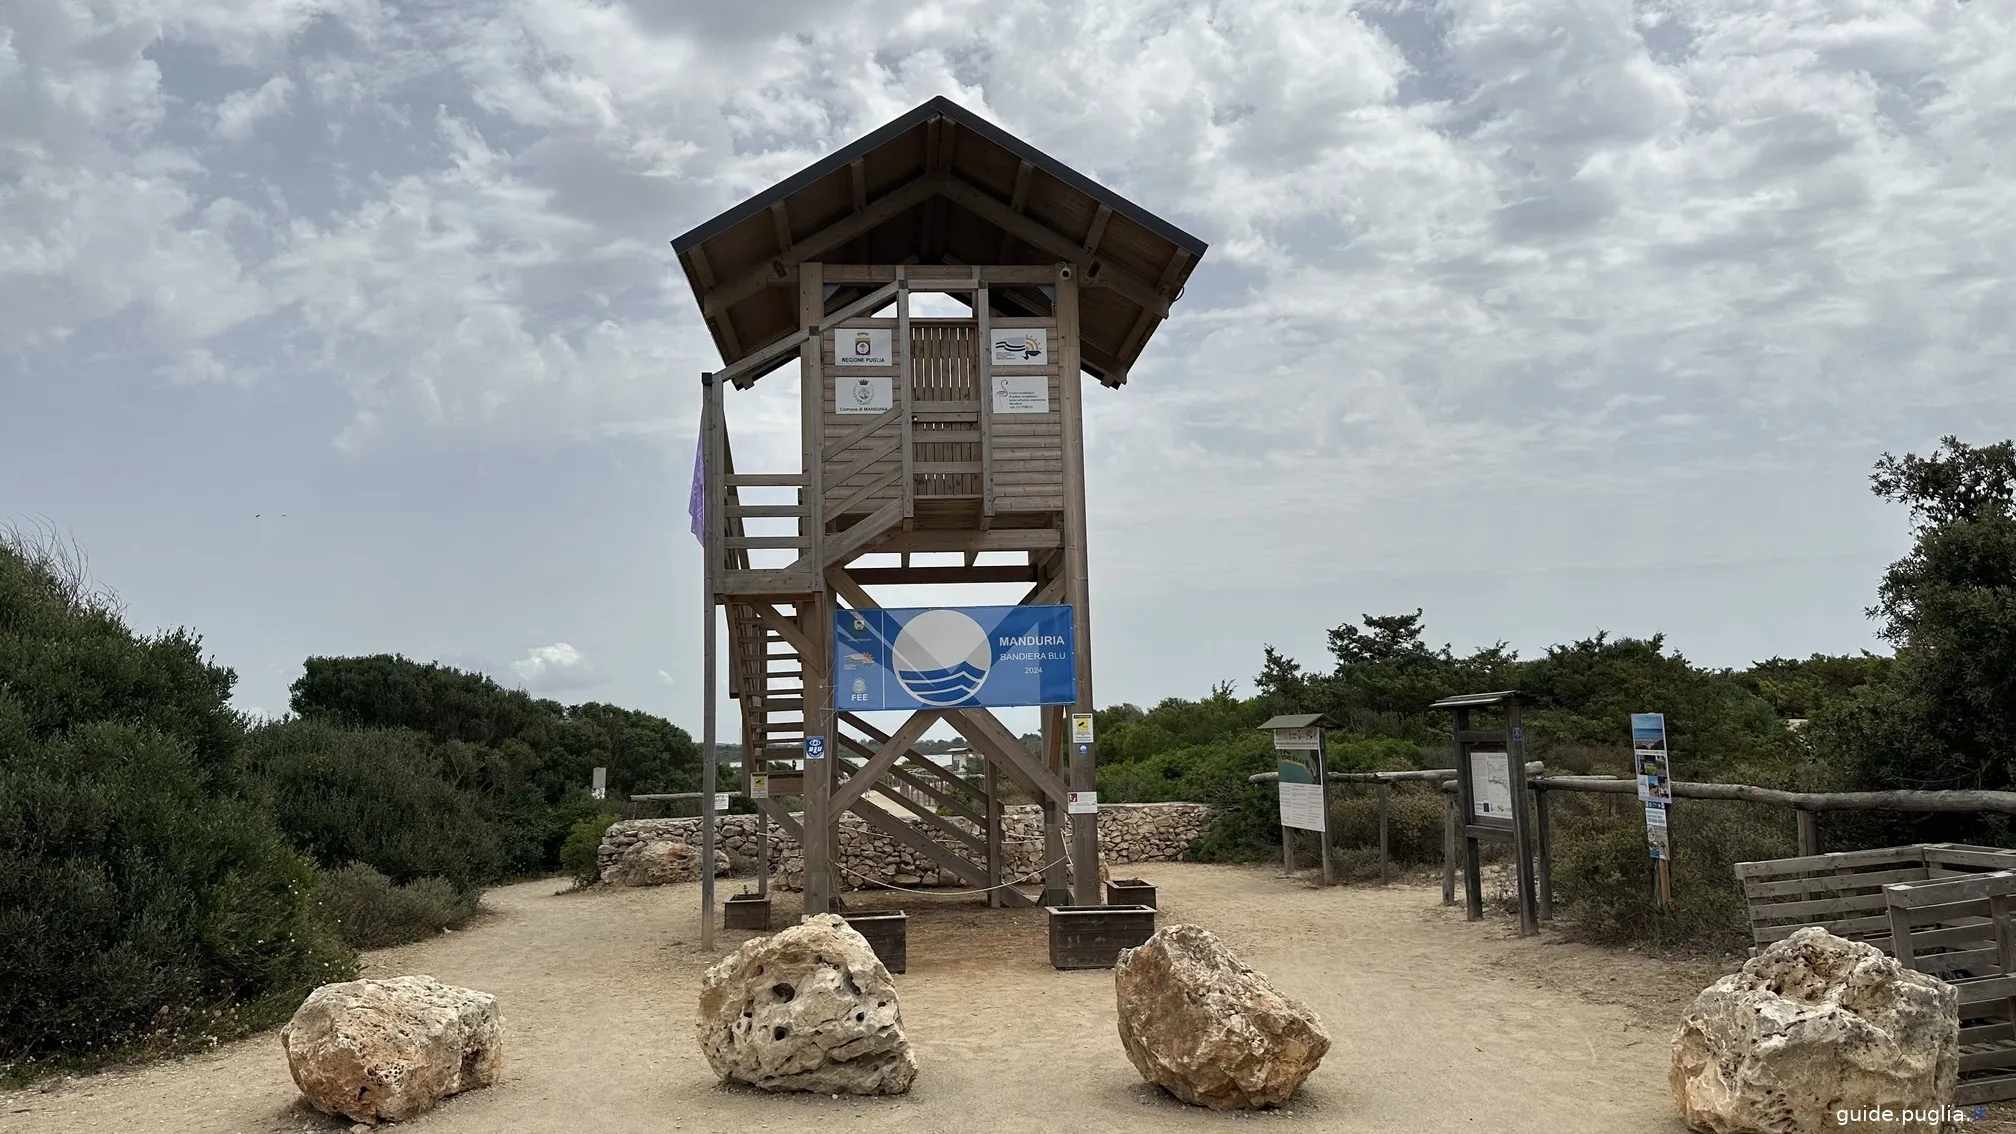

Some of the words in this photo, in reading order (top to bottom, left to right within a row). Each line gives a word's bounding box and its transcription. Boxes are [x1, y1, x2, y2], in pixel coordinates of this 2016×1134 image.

[1000, 636, 1065, 646] MANDURIA
[1000, 652, 1047, 661] BANDIERA
[1048, 652, 1066, 660] BLU
[1024, 666, 1043, 674] 2024
[851, 693, 868, 702] FEE
